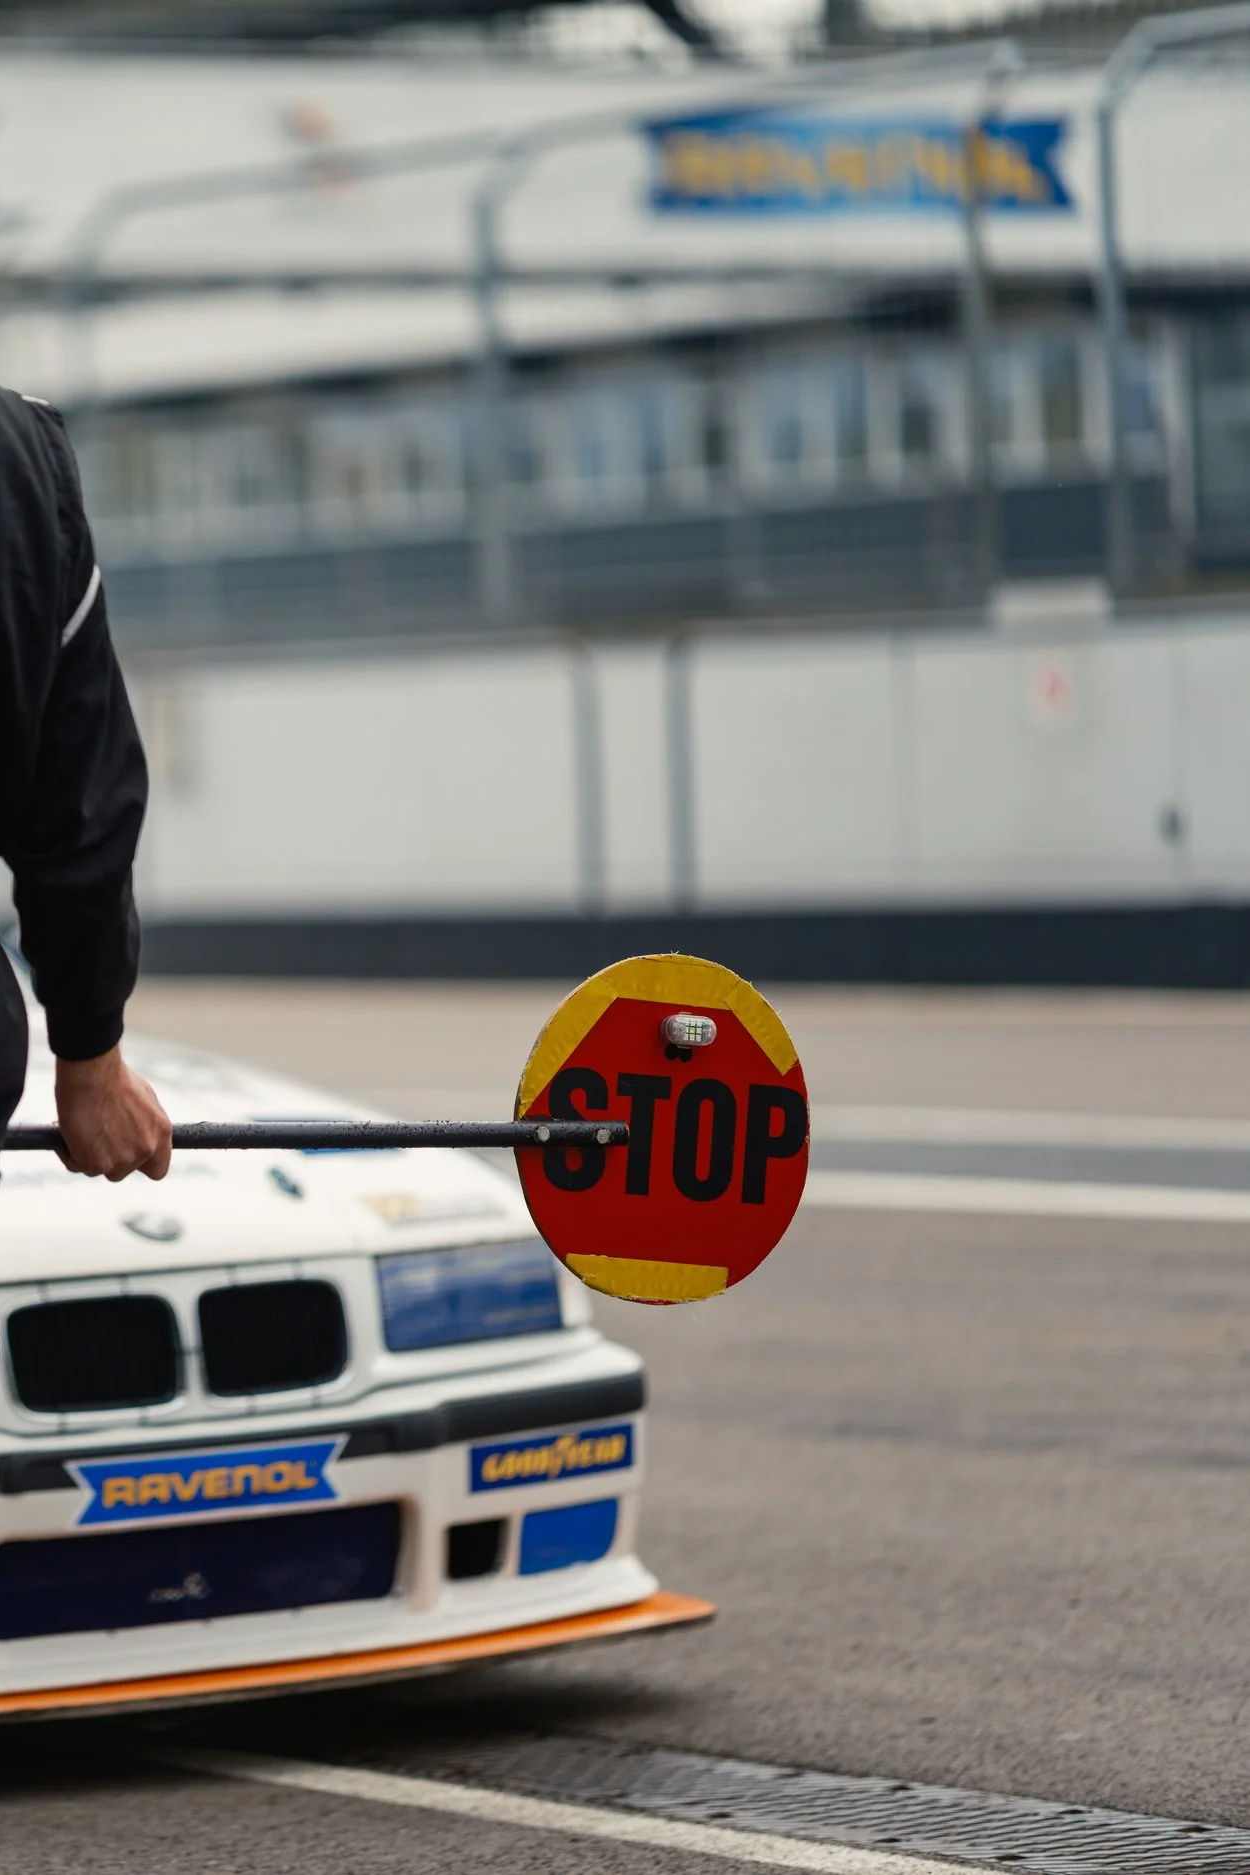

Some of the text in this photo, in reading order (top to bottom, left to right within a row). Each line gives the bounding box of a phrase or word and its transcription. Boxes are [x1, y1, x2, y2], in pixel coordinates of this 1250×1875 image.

[543, 1067, 807, 1205] STOP
[481, 1433, 626, 1482] GOODYEAR
[102, 1460, 318, 1509] RAVENOL
